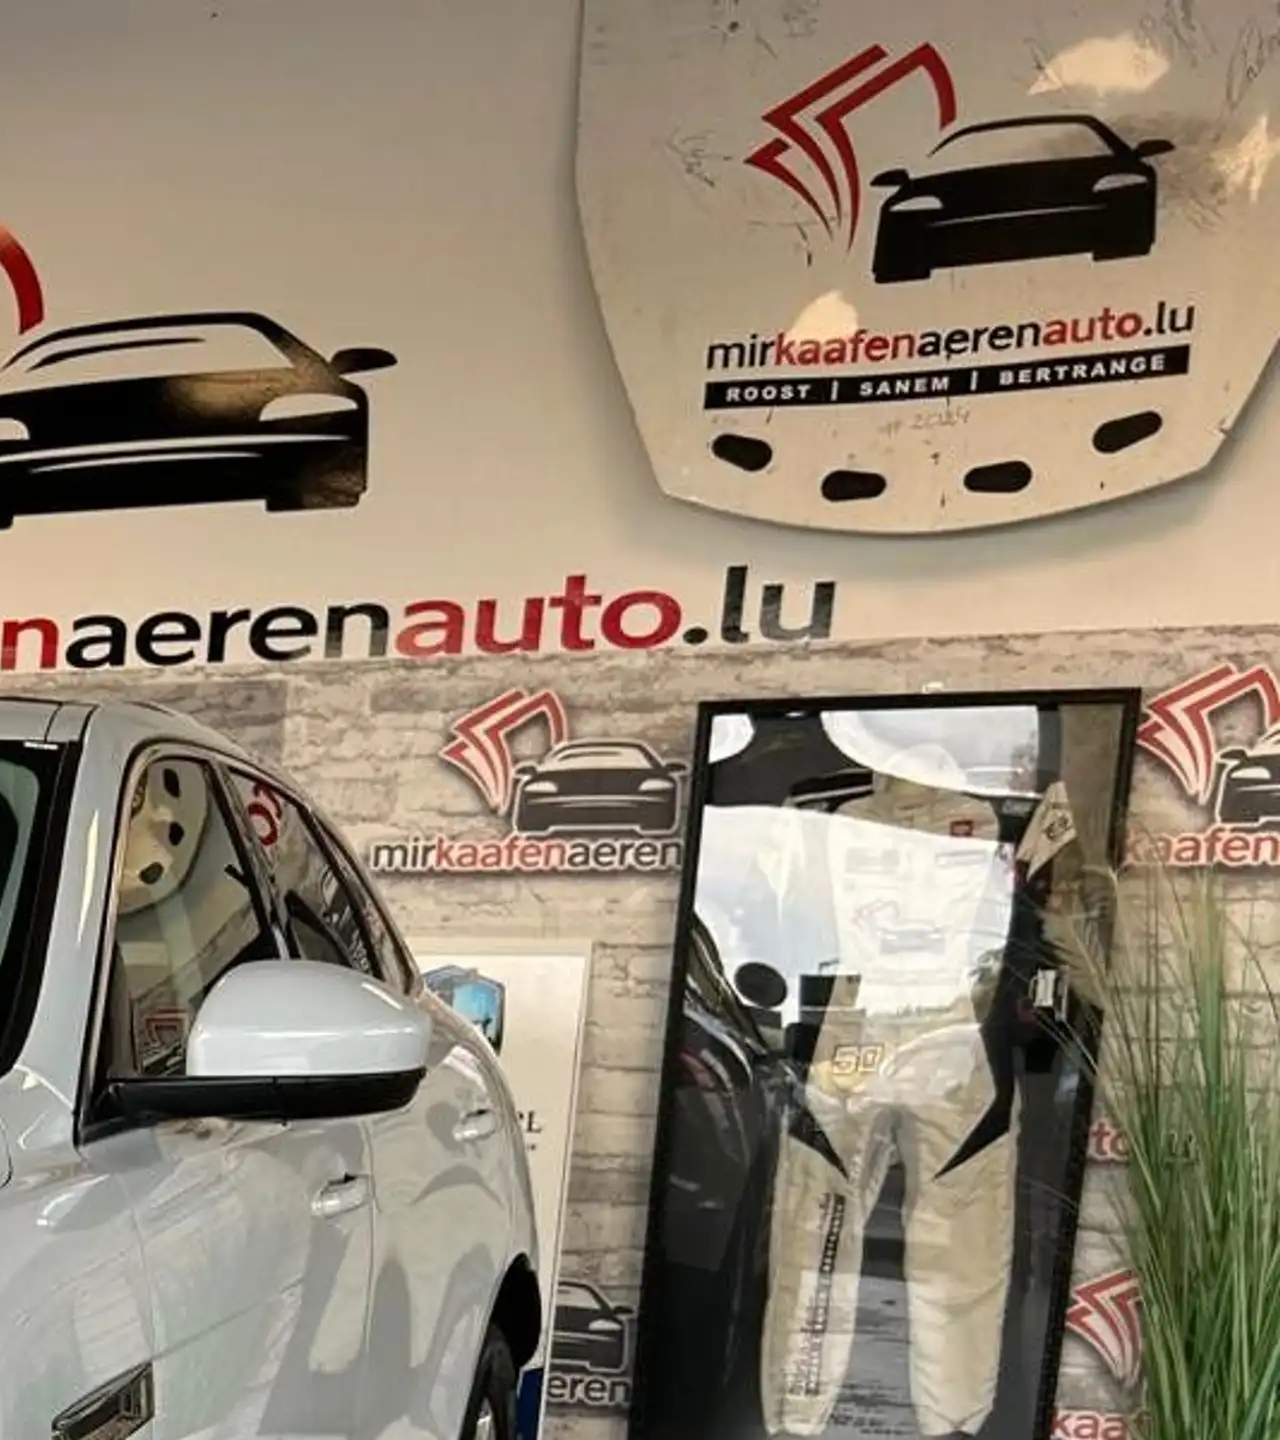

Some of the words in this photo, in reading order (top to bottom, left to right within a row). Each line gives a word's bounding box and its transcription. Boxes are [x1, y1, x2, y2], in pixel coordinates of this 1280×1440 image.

[707, 301, 1195, 370] mirkaafenaerenauto.lu
[726, 384, 811, 402] ROOST
[859, 376, 950, 397] SANEM
[999, 354, 1166, 386] BERTRANGE
[371, 836, 681, 869] mirkaafenaeren
